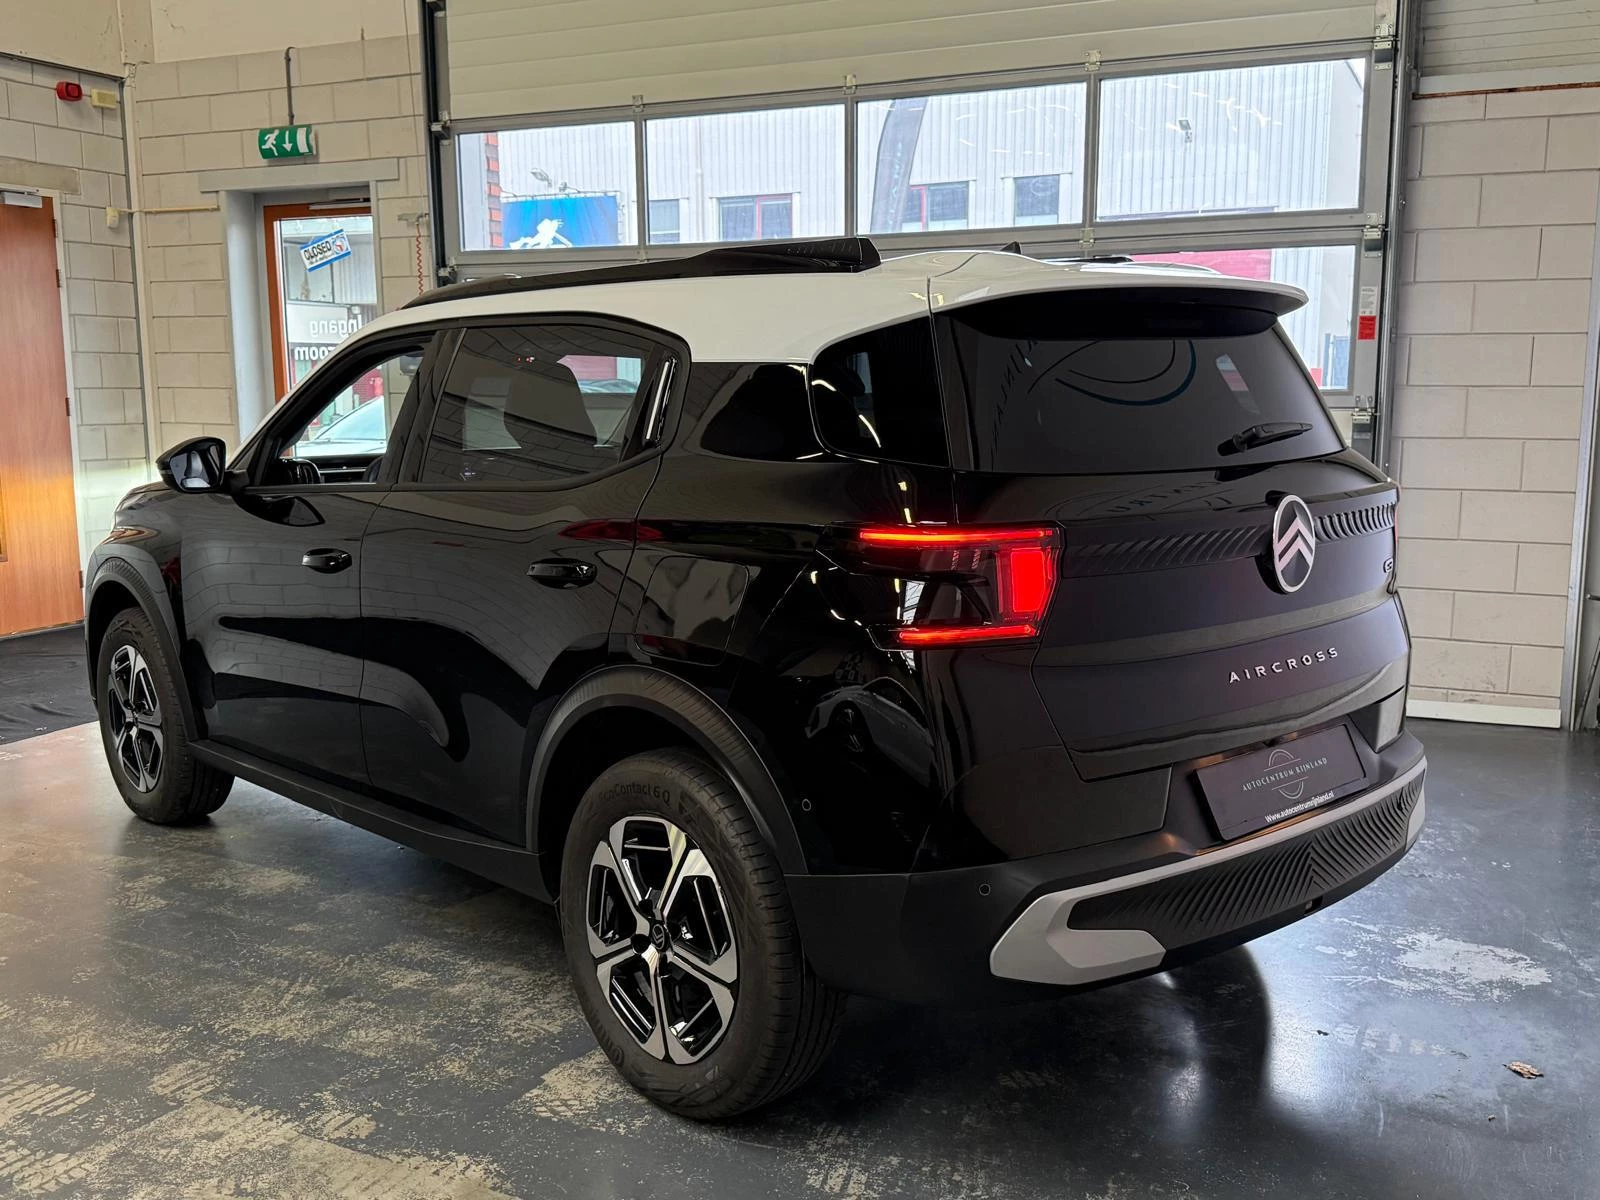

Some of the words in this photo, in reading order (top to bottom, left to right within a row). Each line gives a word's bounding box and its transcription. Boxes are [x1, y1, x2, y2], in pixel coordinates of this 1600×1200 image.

[303, 240, 332, 261] CLOSED
[1228, 647, 1339, 684] AIRCROSS
[1242, 768, 1294, 792] AUTOCENTRUM
[1296, 757, 1328, 774] RIJNLAND
